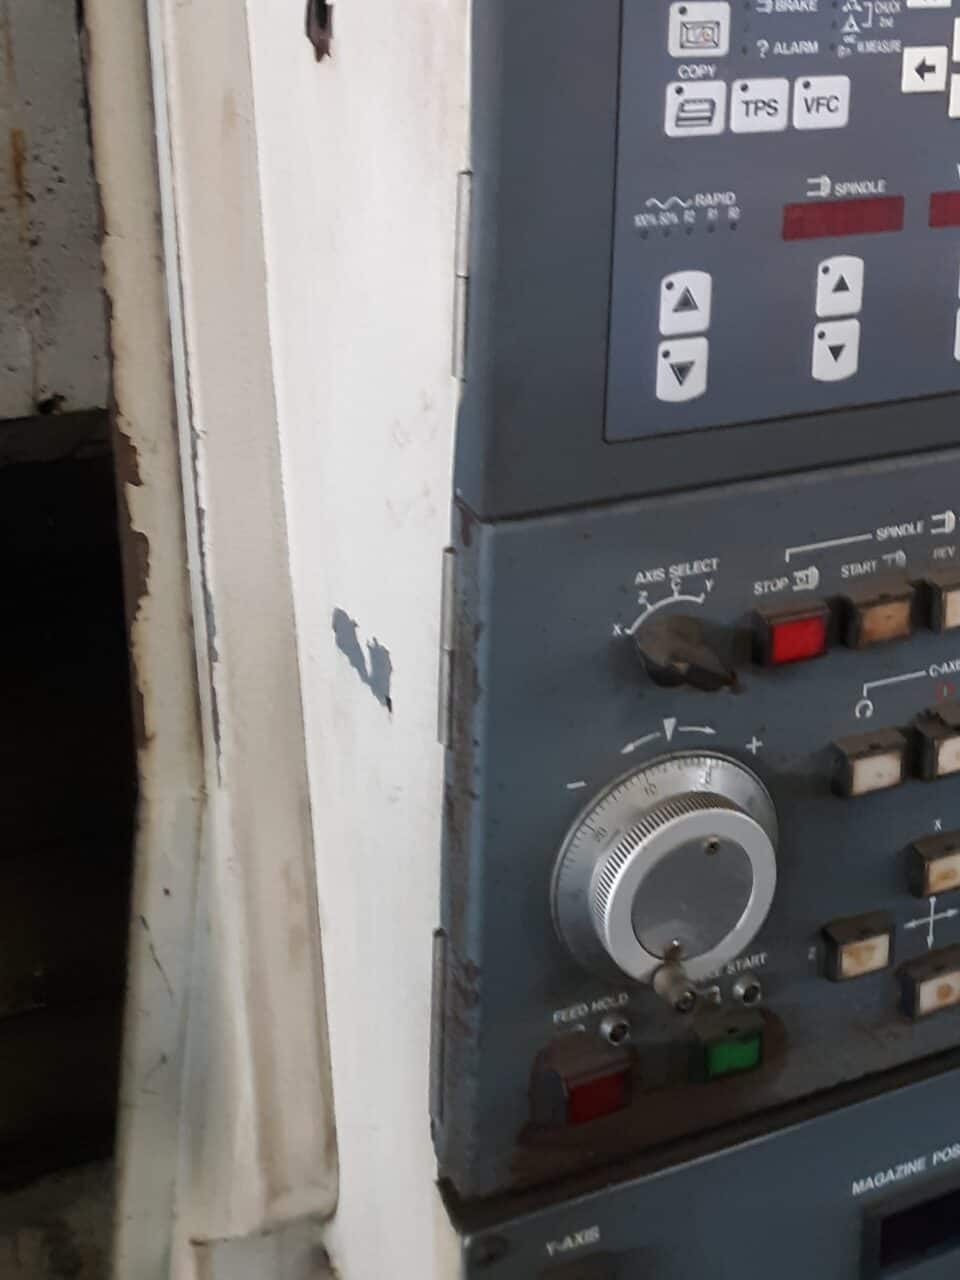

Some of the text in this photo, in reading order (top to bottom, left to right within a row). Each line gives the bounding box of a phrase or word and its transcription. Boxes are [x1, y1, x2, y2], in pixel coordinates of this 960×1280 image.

[773, 40, 819, 54] ALARM
[678, 65, 716, 78] COPY
[742, 99, 779, 118] TPS
[804, 96, 839, 114] VFC
[834, 178, 886, 195] SPINDLE
[695, 191, 736, 207] RAPID
[876, 521, 924, 540] SPINDLE
[635, 557, 720, 584] AXIS SELECT
[841, 562, 877, 578] START
[754, 579, 788, 595] STOP
[553, 992, 629, 1023] FEED HOLD
[852, 1156, 927, 1196] MAGAZINE
[546, 1225, 599, 1256] Y-AXIS
